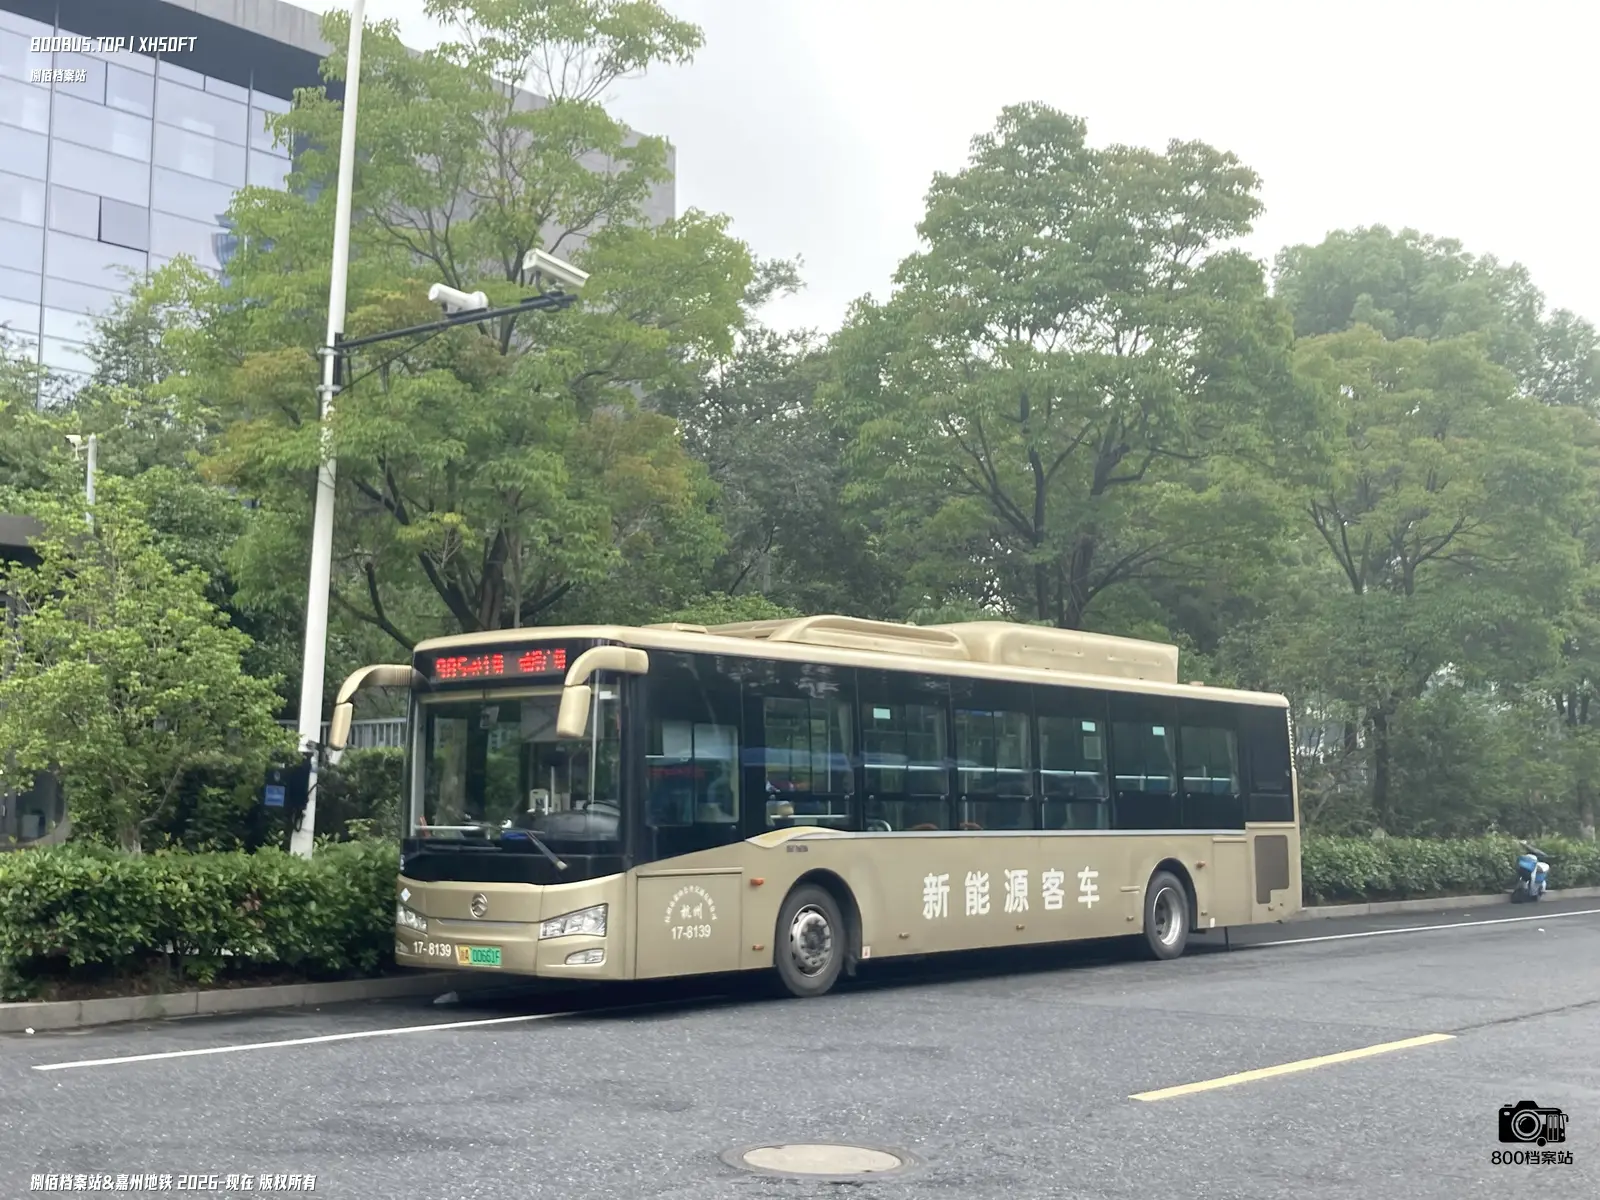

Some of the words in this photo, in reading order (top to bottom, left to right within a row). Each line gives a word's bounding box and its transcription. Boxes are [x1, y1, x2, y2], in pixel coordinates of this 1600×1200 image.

[922, 866, 1100, 920] 新能源客车
[671, 924, 712, 940] 17-8139
[412, 941, 452, 957] 17-8139
